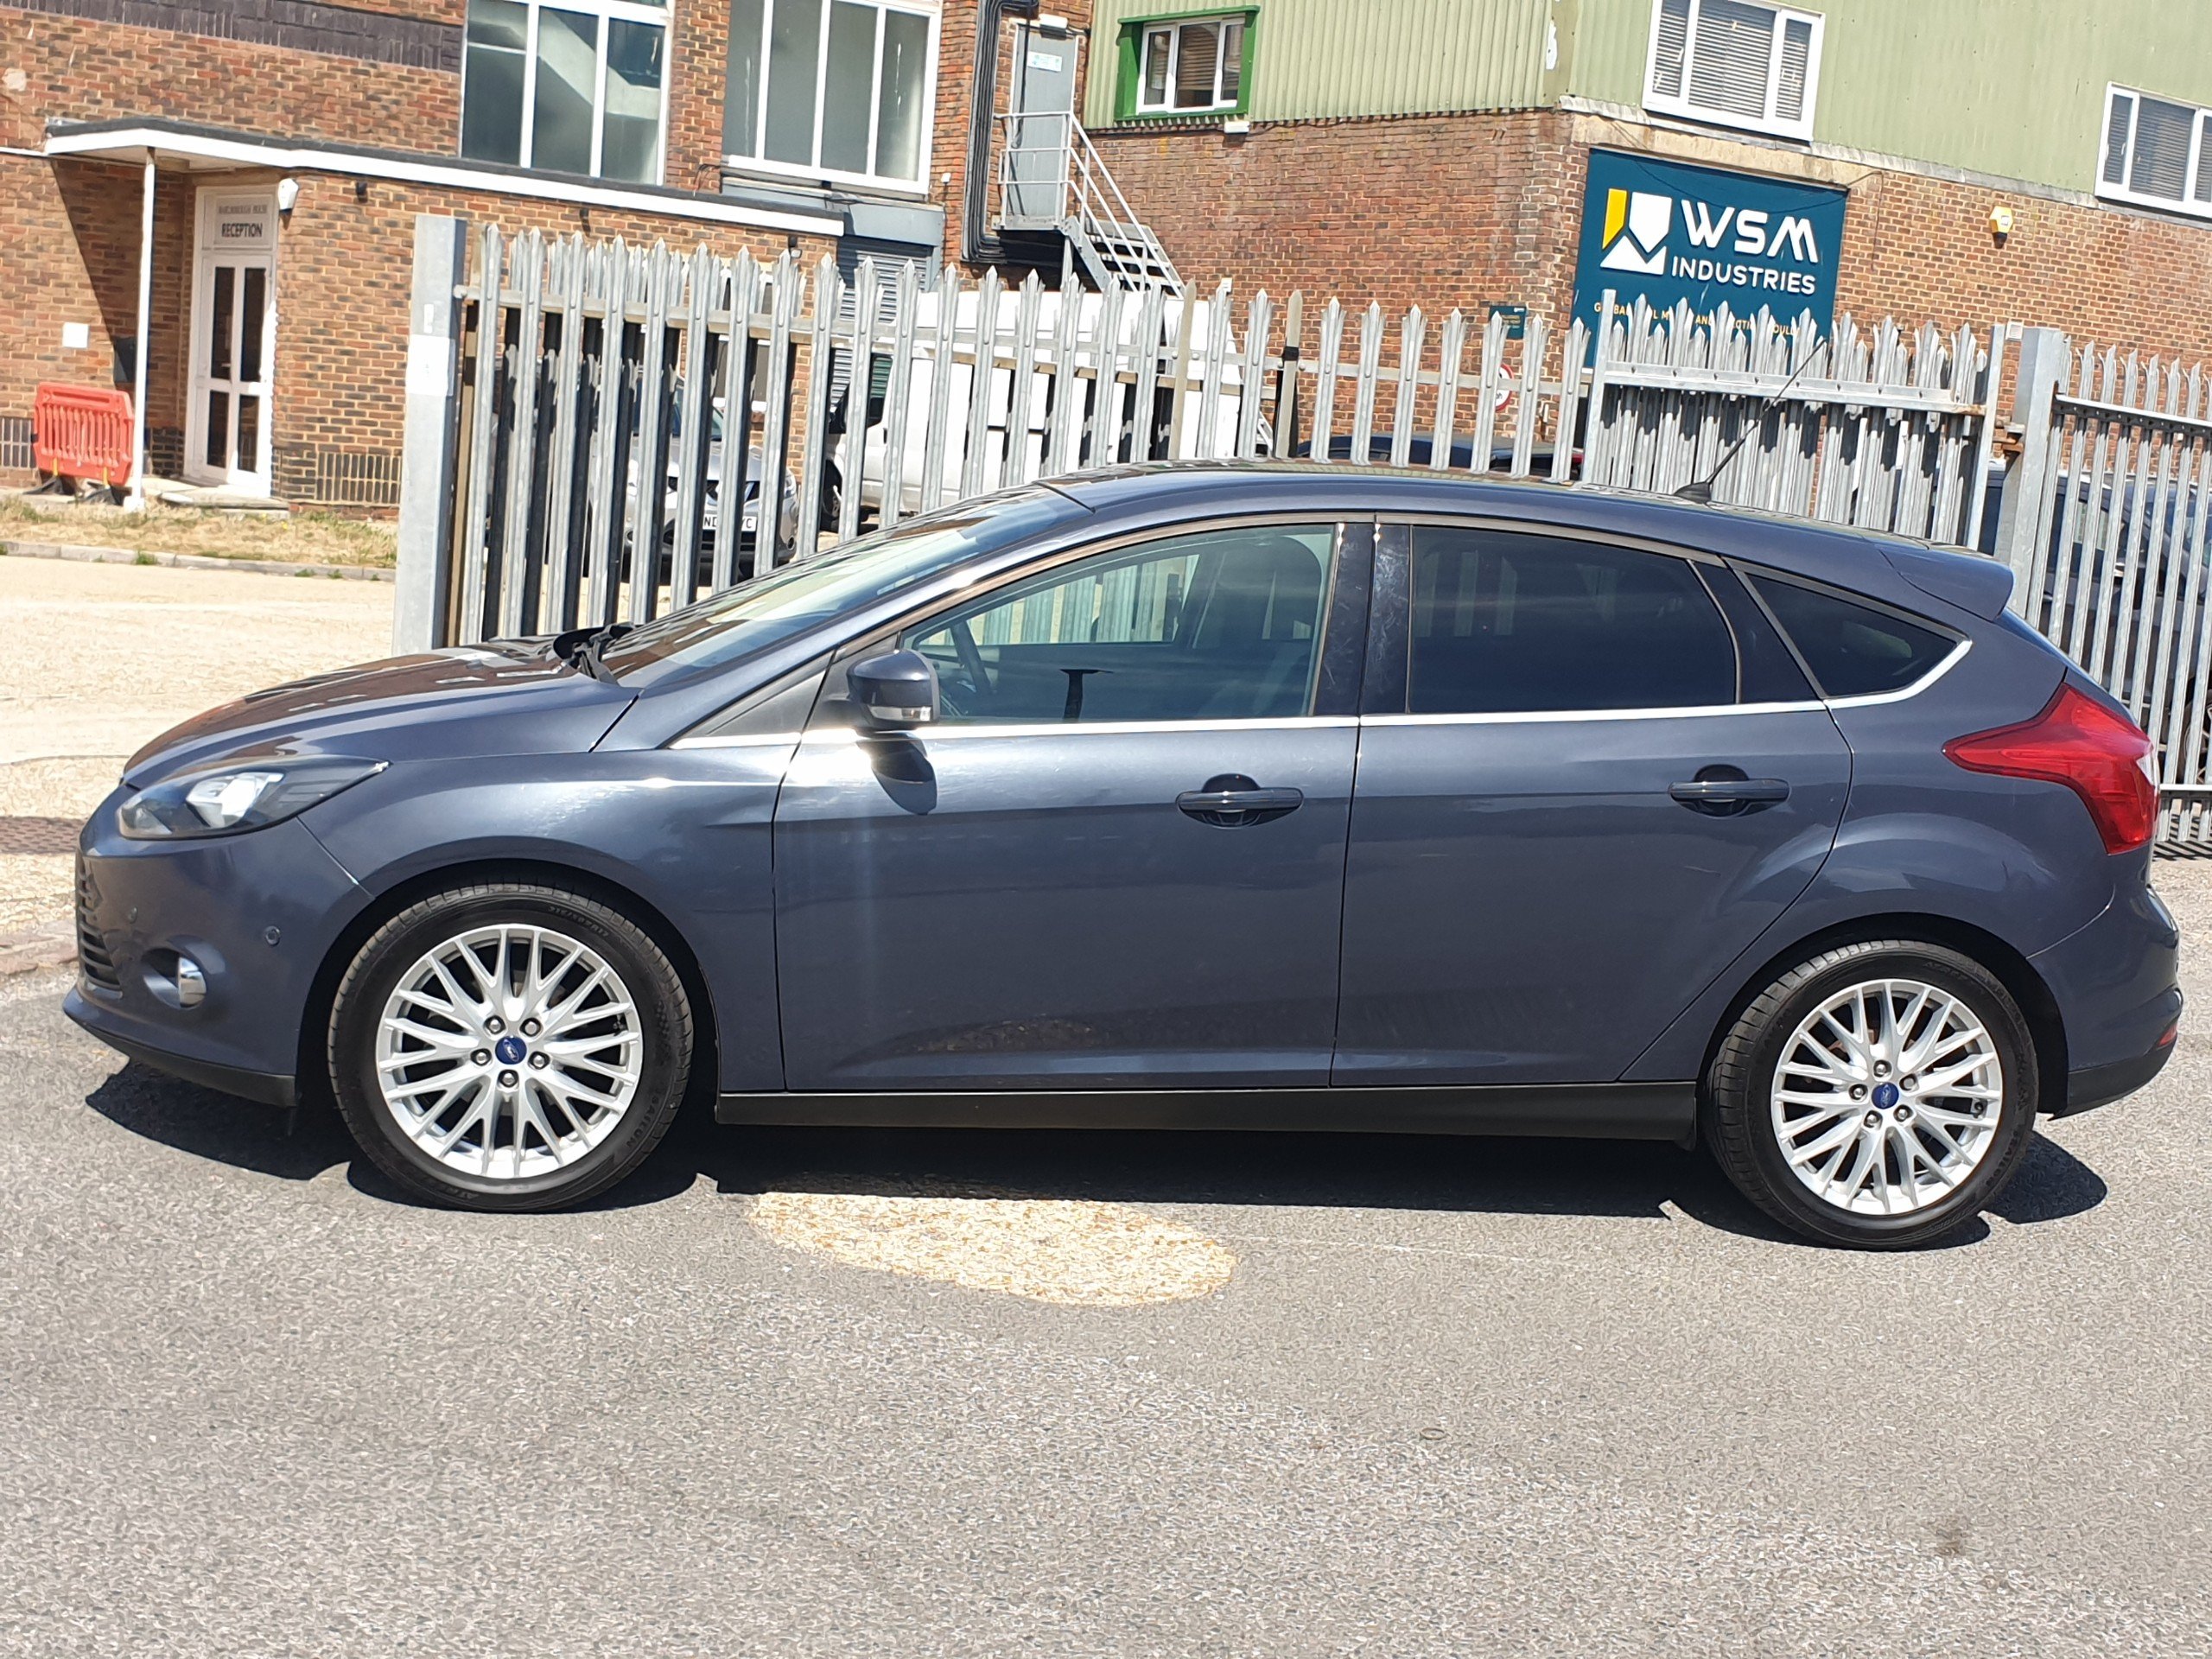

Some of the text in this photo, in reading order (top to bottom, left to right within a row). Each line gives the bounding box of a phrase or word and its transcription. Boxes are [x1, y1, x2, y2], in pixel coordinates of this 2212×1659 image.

[221, 222, 263, 238] RECEPTION
[1681, 200, 1819, 264] WSM
[1671, 255, 1816, 296] INDUSTRIES
